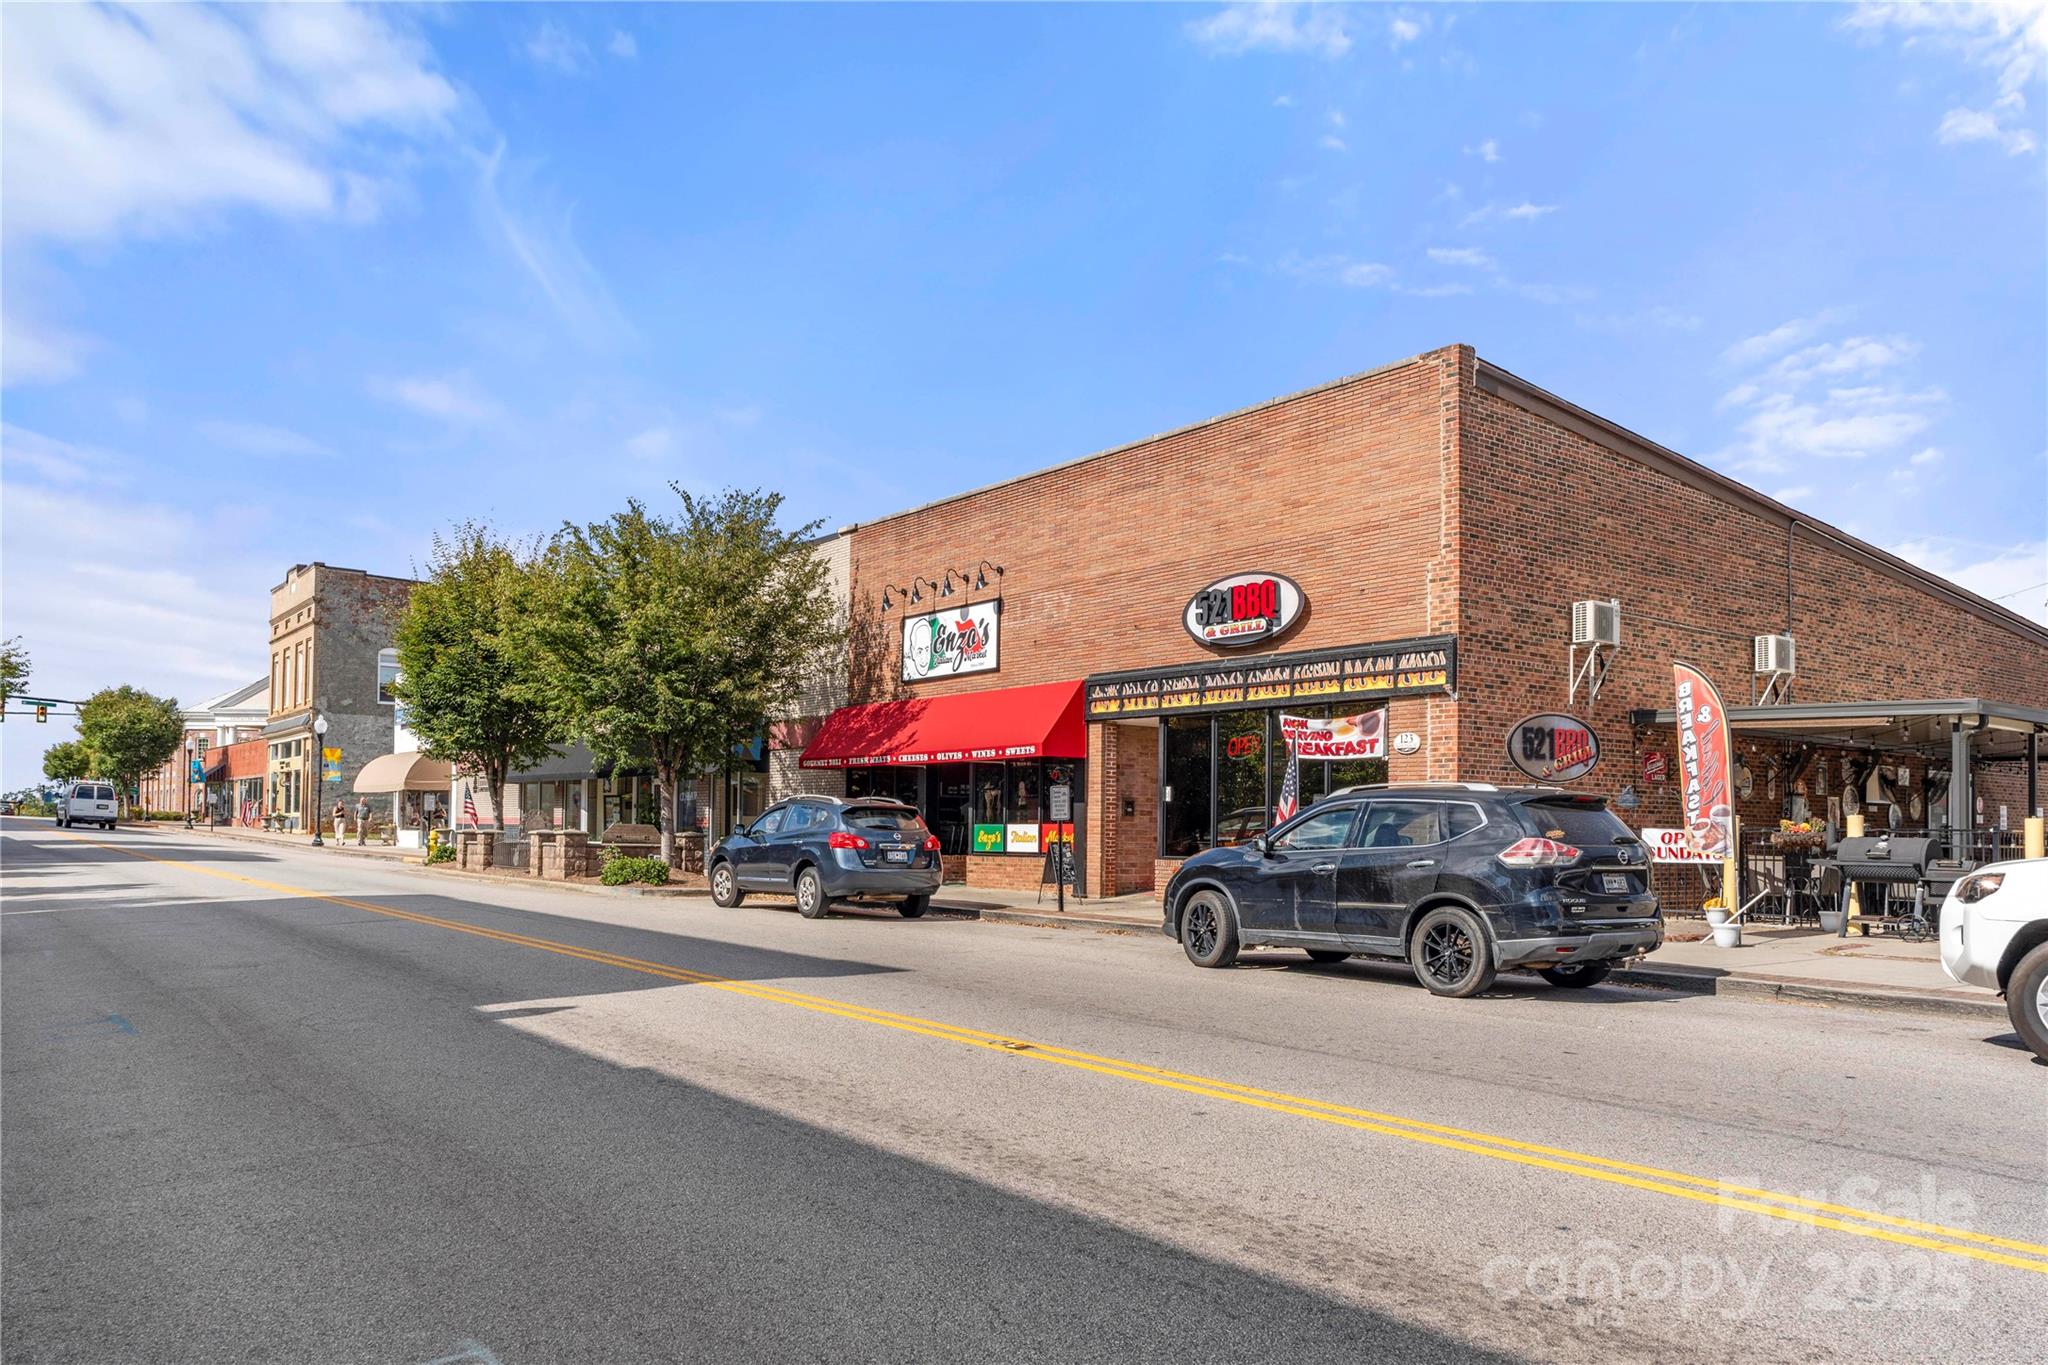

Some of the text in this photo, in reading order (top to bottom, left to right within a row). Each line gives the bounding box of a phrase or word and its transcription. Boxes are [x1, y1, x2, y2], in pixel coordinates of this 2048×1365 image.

[1220, 620, 1264, 636] GRILL
[932, 617, 990, 672] Enzo's
[870, 755, 891, 764] MEATS
[898, 753, 928, 762] CHEESES
[936, 752, 962, 760] OLIVES
[971, 749, 996, 758] WINES
[1005, 745, 1036, 756] SWEETS
[1553, 746, 1596, 772] GRILL
